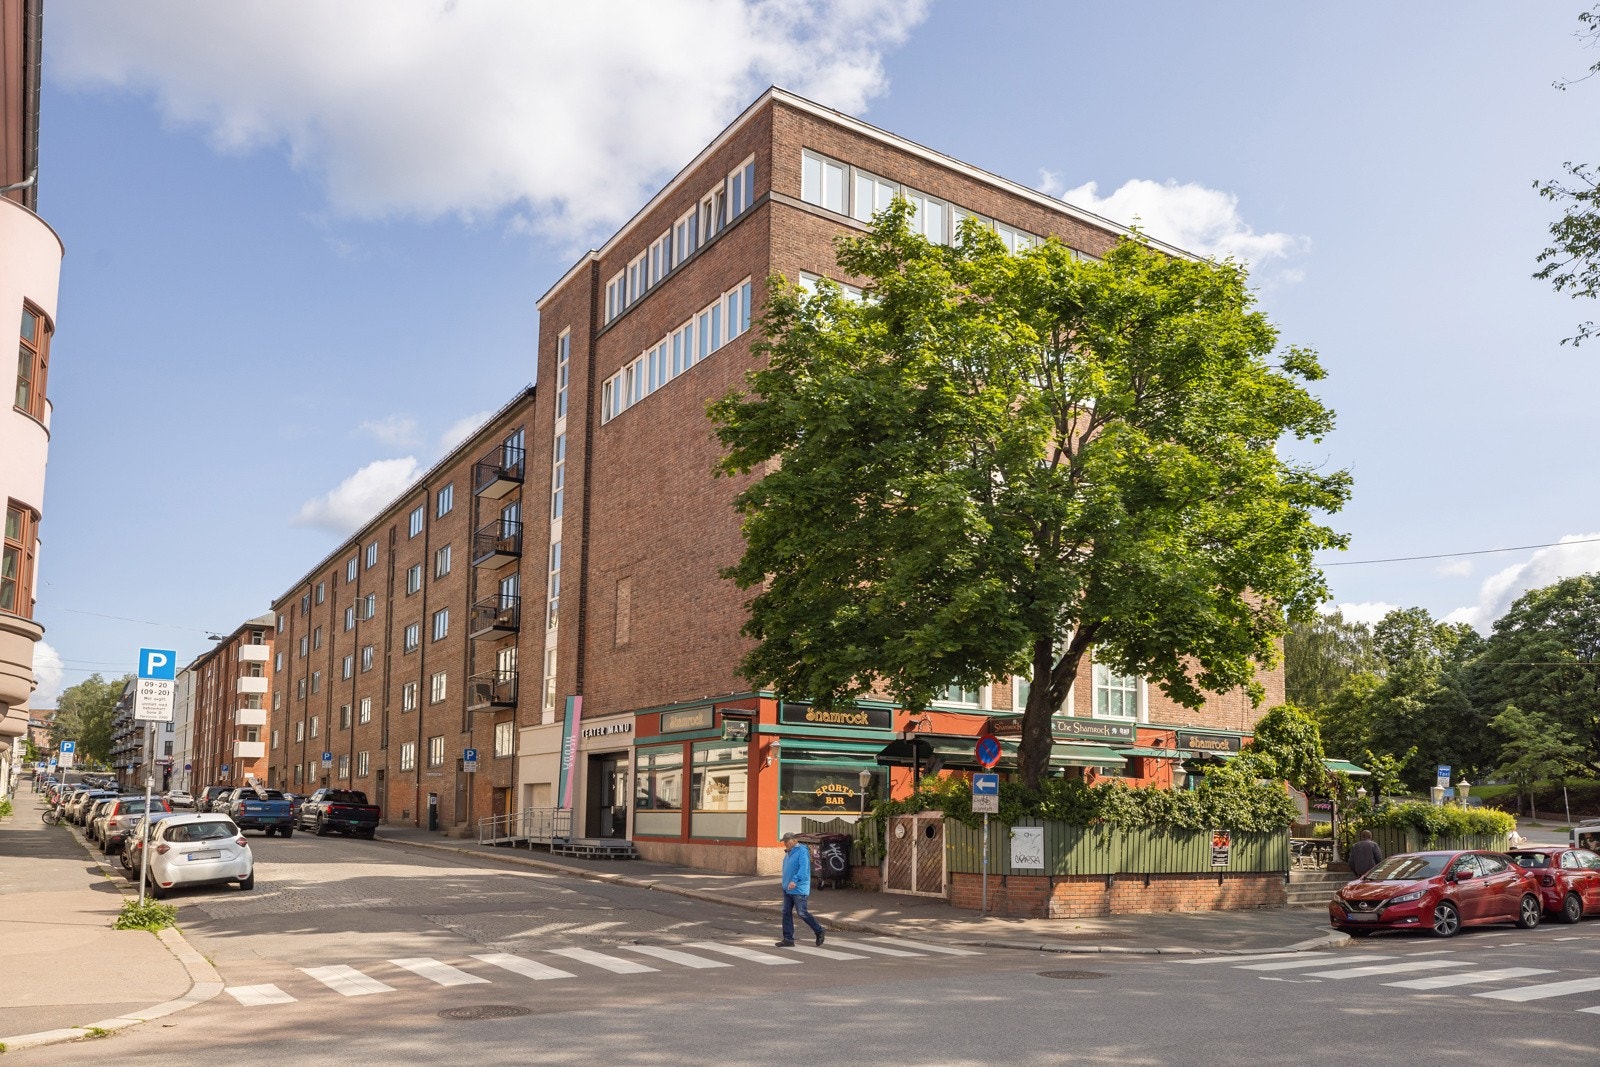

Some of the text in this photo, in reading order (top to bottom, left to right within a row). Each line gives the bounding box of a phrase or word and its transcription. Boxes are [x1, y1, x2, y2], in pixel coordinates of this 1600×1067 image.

[147, 652, 168, 676] P
[144, 681, 168, 689] 09-20
[582, 723, 631, 738] TEATER MANU
[1057, 721, 1072, 732] The
[1073, 722, 1110, 736] Shamrock
[64, 743, 71, 751] P
[1189, 736, 1230, 750] Shamrock
[467, 750, 474, 760] P
[815, 783, 855, 798] SPORTS
[825, 796, 845, 805] BAR
